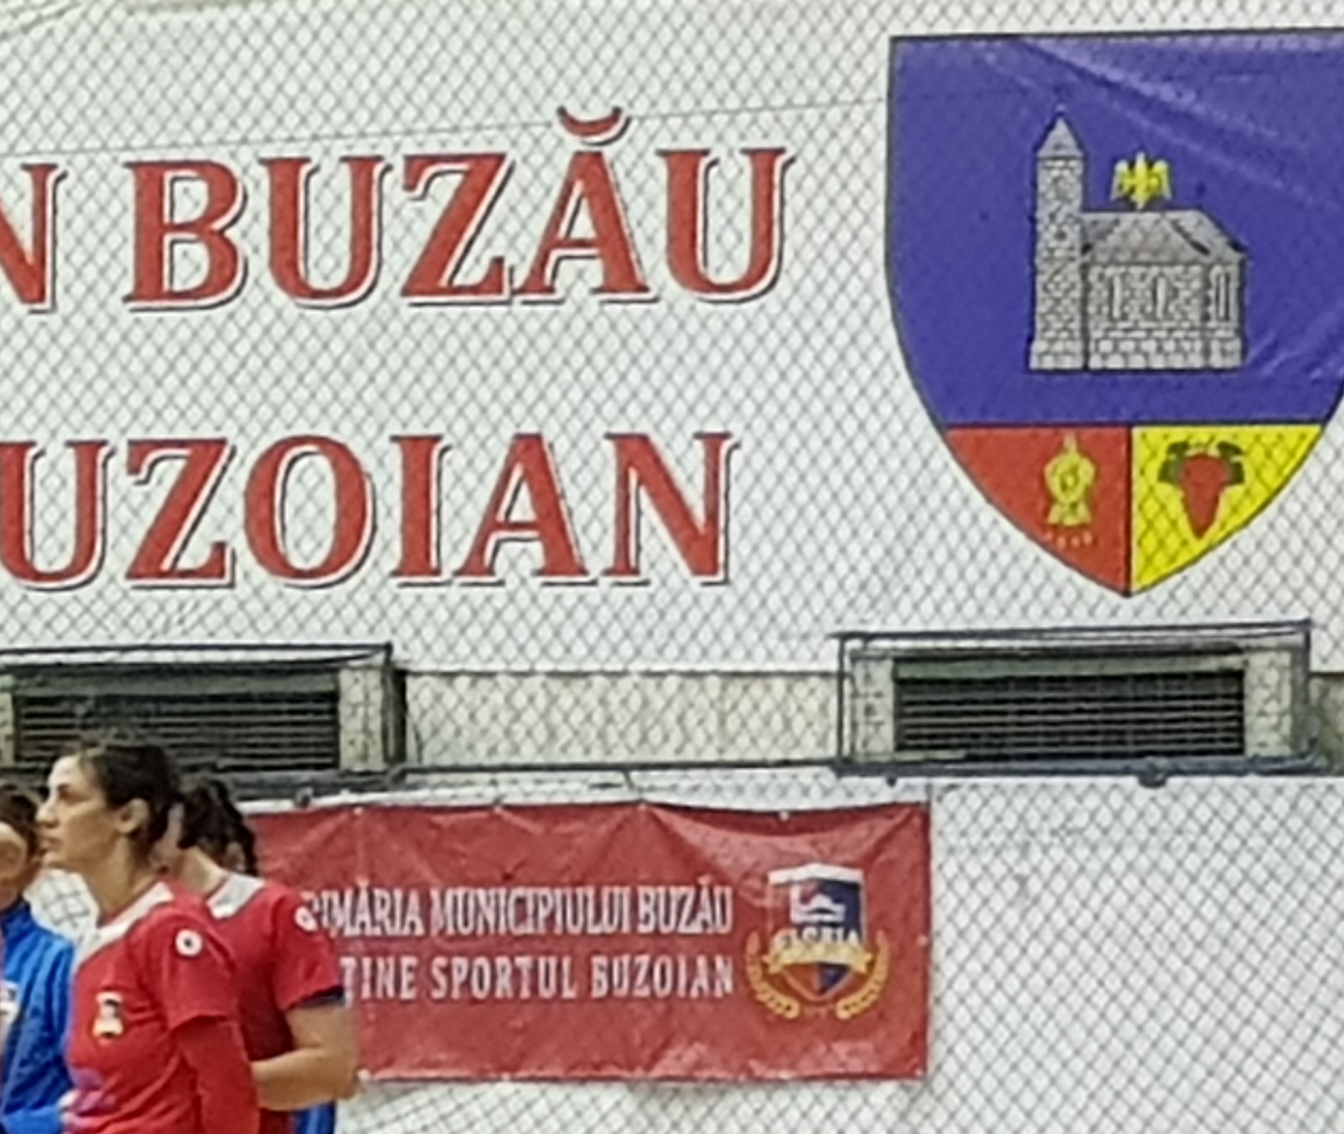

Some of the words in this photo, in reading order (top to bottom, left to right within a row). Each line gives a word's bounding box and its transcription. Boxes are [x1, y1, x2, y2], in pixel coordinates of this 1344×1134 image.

[123, 106, 790, 312] BUZĂU
[430, 884, 631, 936] MUNICIPIULUI
[637, 874, 733, 935] BUZĂU
[431, 955, 578, 999] SPORTUL
[590, 954, 733, 999] BUZOIAN
